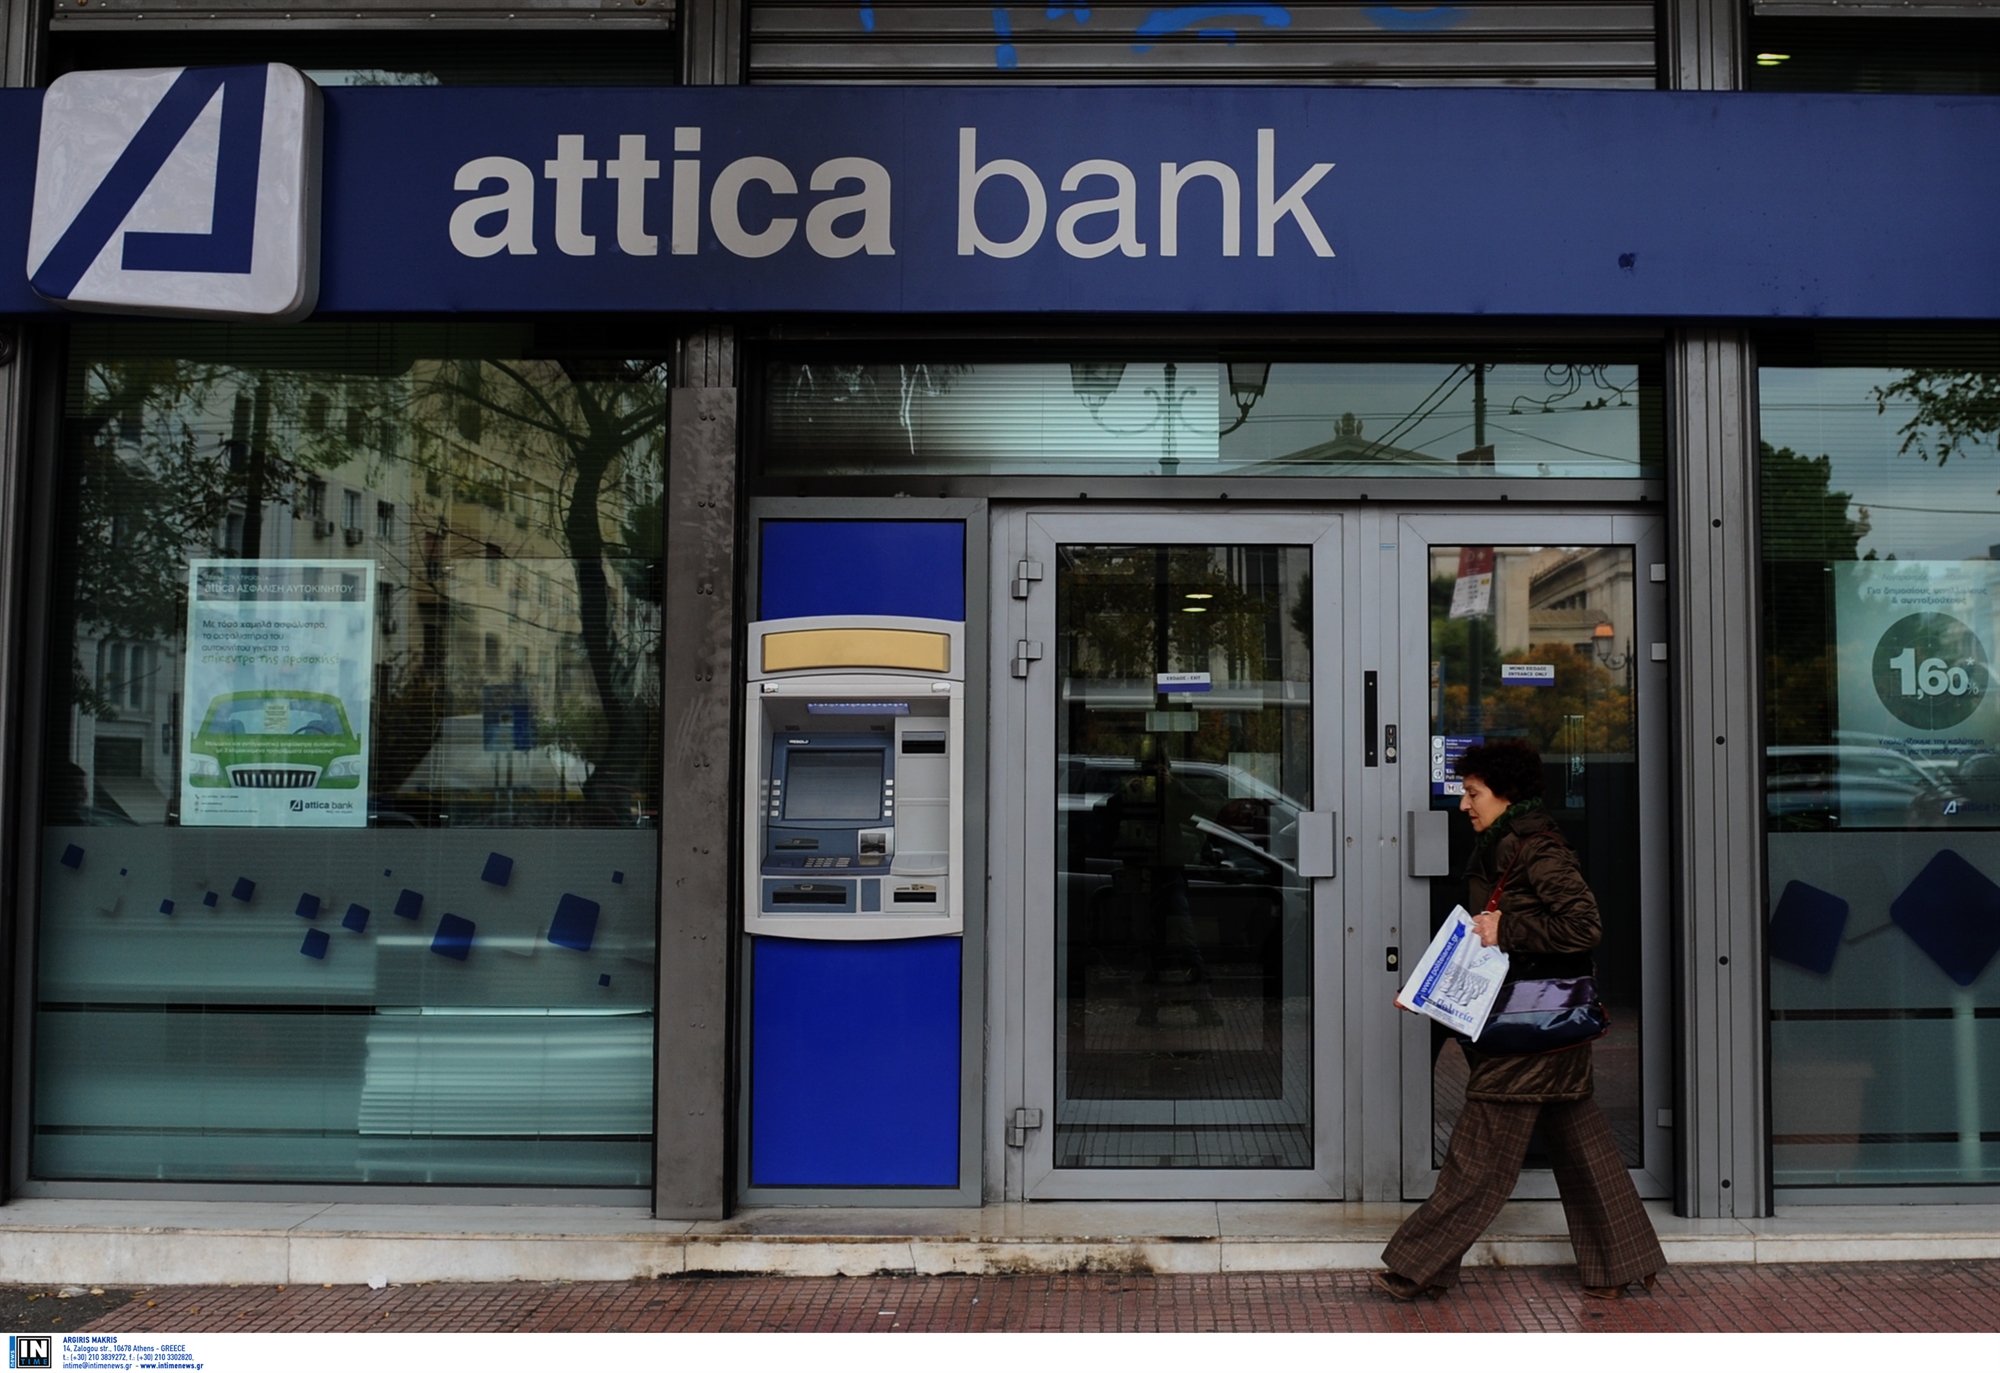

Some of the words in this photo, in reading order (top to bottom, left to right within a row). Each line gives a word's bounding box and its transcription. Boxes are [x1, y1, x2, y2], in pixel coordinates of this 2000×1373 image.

[450, 127, 896, 259] attica
[957, 127, 1336, 259] bank
[204, 583, 235, 593] attica
[236, 584, 284, 593] ΑΣΦΑΛΙΣΗ
[286, 584, 354, 593] ΑΥΤΟΚΙΝΗΤΟΥ
[1883, 586, 1931, 595] δημοσίους
[202, 620, 215, 628] Με
[217, 620, 238, 628] τόσο
[240, 620, 272, 629] χαμηλά
[274, 620, 327, 630] ασφάλιστρα,
[201, 643, 251, 651] αυτοκινήτου
[201, 652, 256, 666] επίκεντρο
[259, 654, 279, 665] της
[283, 651, 340, 667] προσοχής!
[304, 800, 330, 810] attica
[331, 801, 353, 810] bank
[1435, 998, 1474, 1024] Πολιτεία
